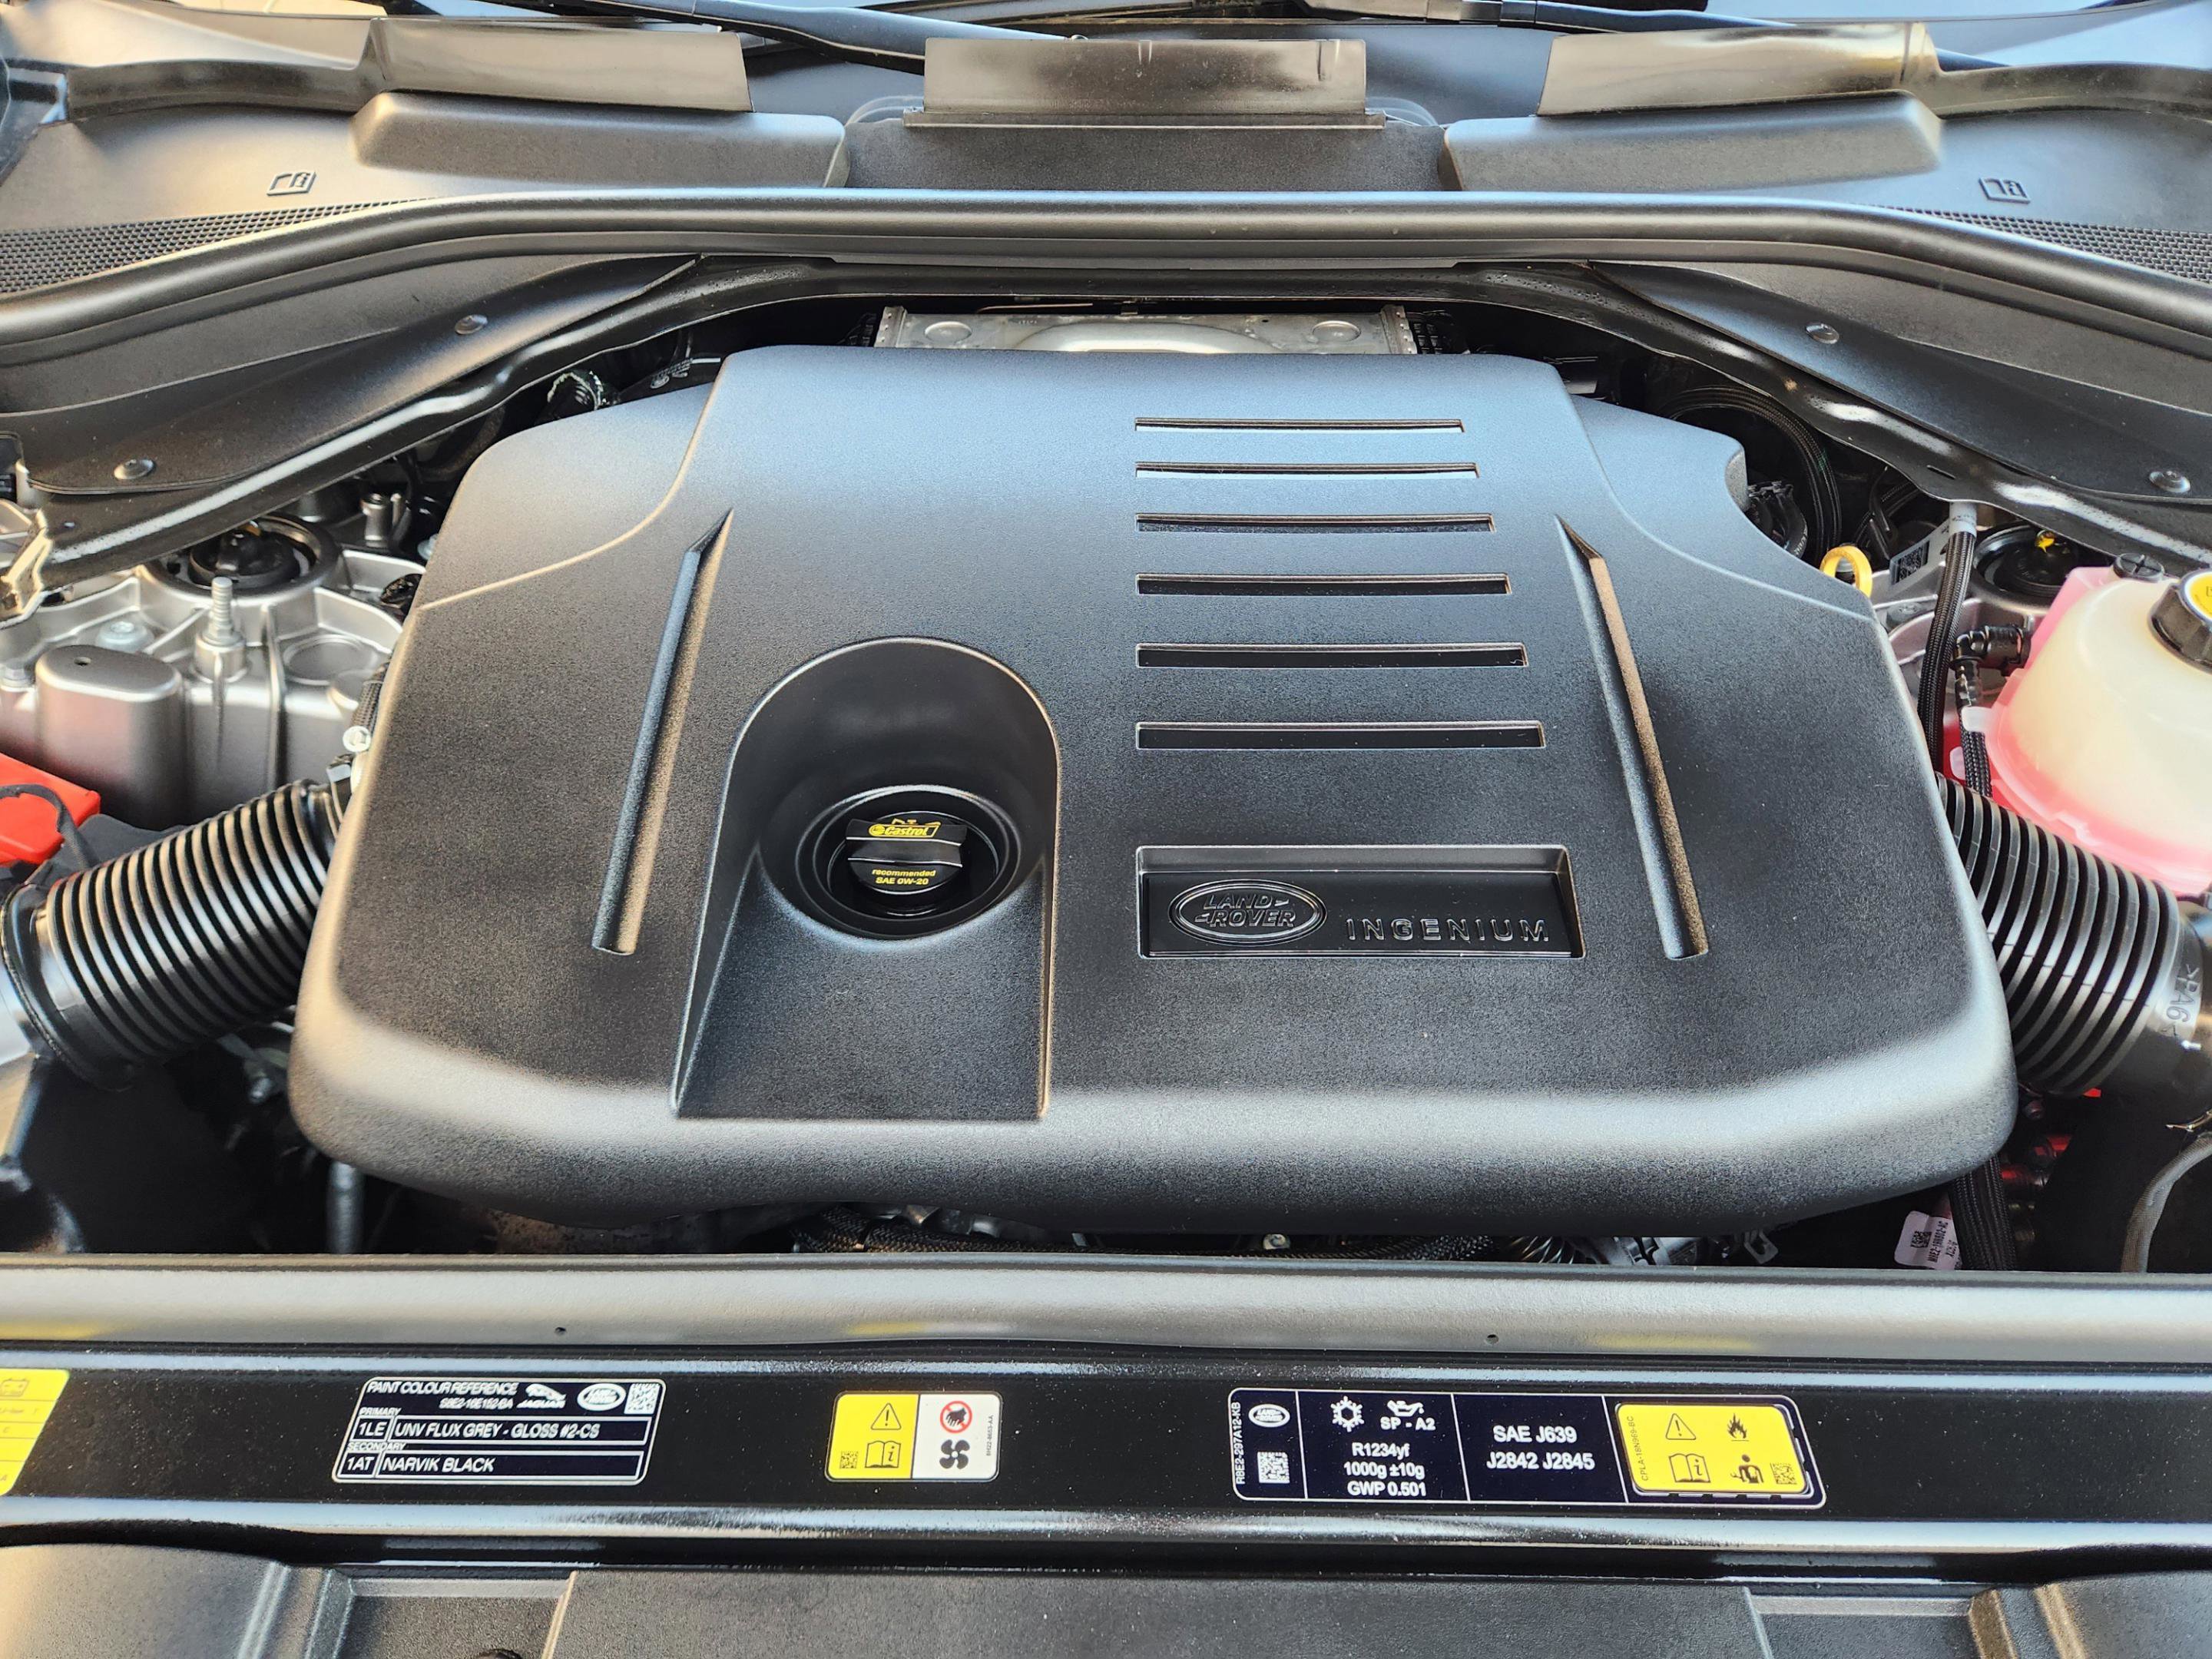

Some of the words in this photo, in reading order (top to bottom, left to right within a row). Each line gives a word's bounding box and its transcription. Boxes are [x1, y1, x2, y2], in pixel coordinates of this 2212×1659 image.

[884, 826, 929, 836] Castrol
[1203, 893, 1273, 910] LAND
[1209, 909, 1296, 928] ROVER
[1346, 919, 1550, 942] INGENIUM
[366, 1381, 402, 1394] PAINT
[401, 1382, 452, 1395] COLOUR
[449, 1382, 520, 1396] REFERENCE
[359, 1406, 402, 1416] PRIMARY
[359, 1422, 388, 1436] 1LE
[394, 1422, 426, 1437] UNV
[426, 1422, 462, 1438] FLUX
[462, 1422, 503, 1439] GREY
[510, 1423, 560, 1439] GLOSS
[1380, 1417, 1402, 1430] SP
[1415, 1418, 1436, 1431] A2
[1492, 1425, 1533, 1442] SAE
[1535, 1426, 1578, 1443] J639
[346, 1442, 407, 1451] SECONDARY
[1351, 1442, 1411, 1460] R1234yf
[347, 1456, 375, 1471] 1AT
[382, 1457, 441, 1472] NARVIK
[442, 1457, 496, 1472] BLACK
[1486, 1451, 1540, 1469] J2842
[1542, 1452, 1595, 1470] J2845
[1343, 1461, 1387, 1479] 1000g
[1389, 1463, 1426, 1480] ±10g
[1346, 1481, 1386, 1496] GWP
[1387, 1482, 1427, 1497] 0.501
